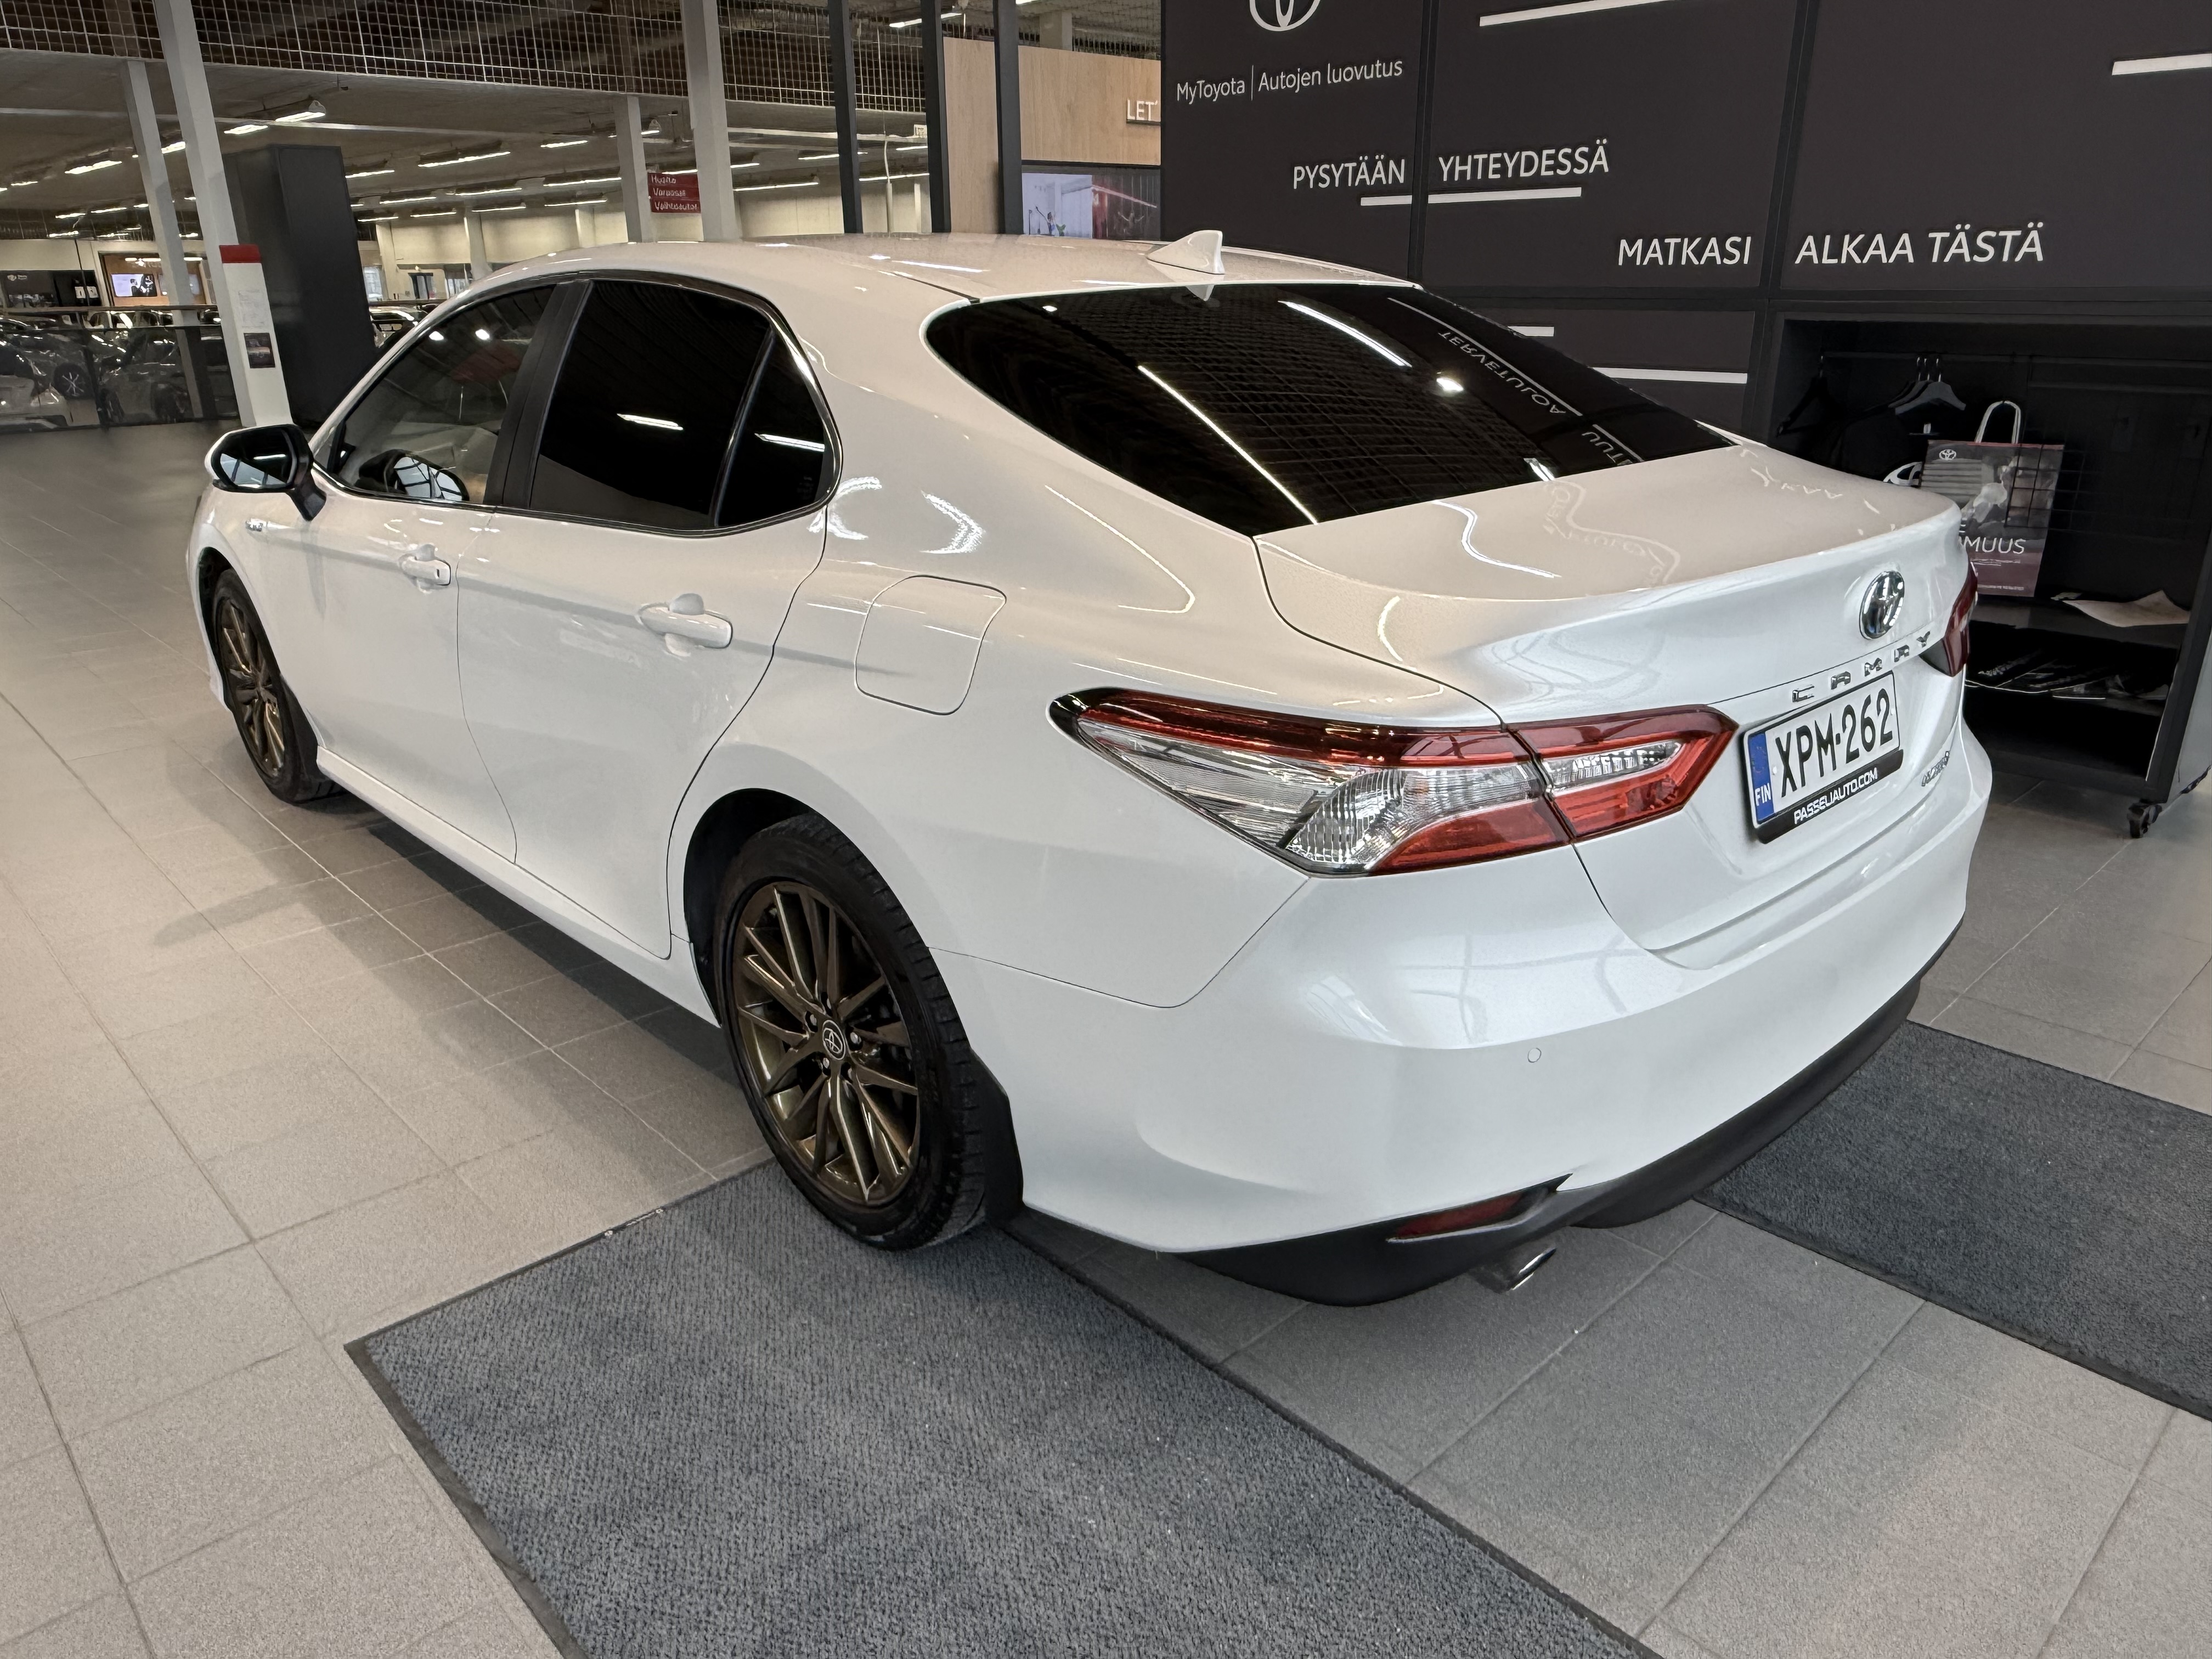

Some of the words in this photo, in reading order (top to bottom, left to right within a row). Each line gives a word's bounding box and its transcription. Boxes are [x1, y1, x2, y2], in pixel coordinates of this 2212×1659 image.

[1177, 77, 1245, 104] MyToyota
[1258, 68, 1321, 93] Autojen
[1327, 59, 1403, 84] luovutus
[1293, 154, 1406, 190] PYSYTÄÄN
[1438, 138, 1609, 182] YHTEYDESSÄ
[1618, 235, 1752, 266] MATKASI
[1795, 232, 1914, 264] ALKAA
[1927, 221, 2044, 263] TÄSTÄ
[1792, 631, 1931, 703] CAMRY
[1775, 688, 1893, 798] XPM-262
[1754, 782, 1771, 806] FIN
[1793, 768, 1878, 825] PASSELIAUTO.COM
